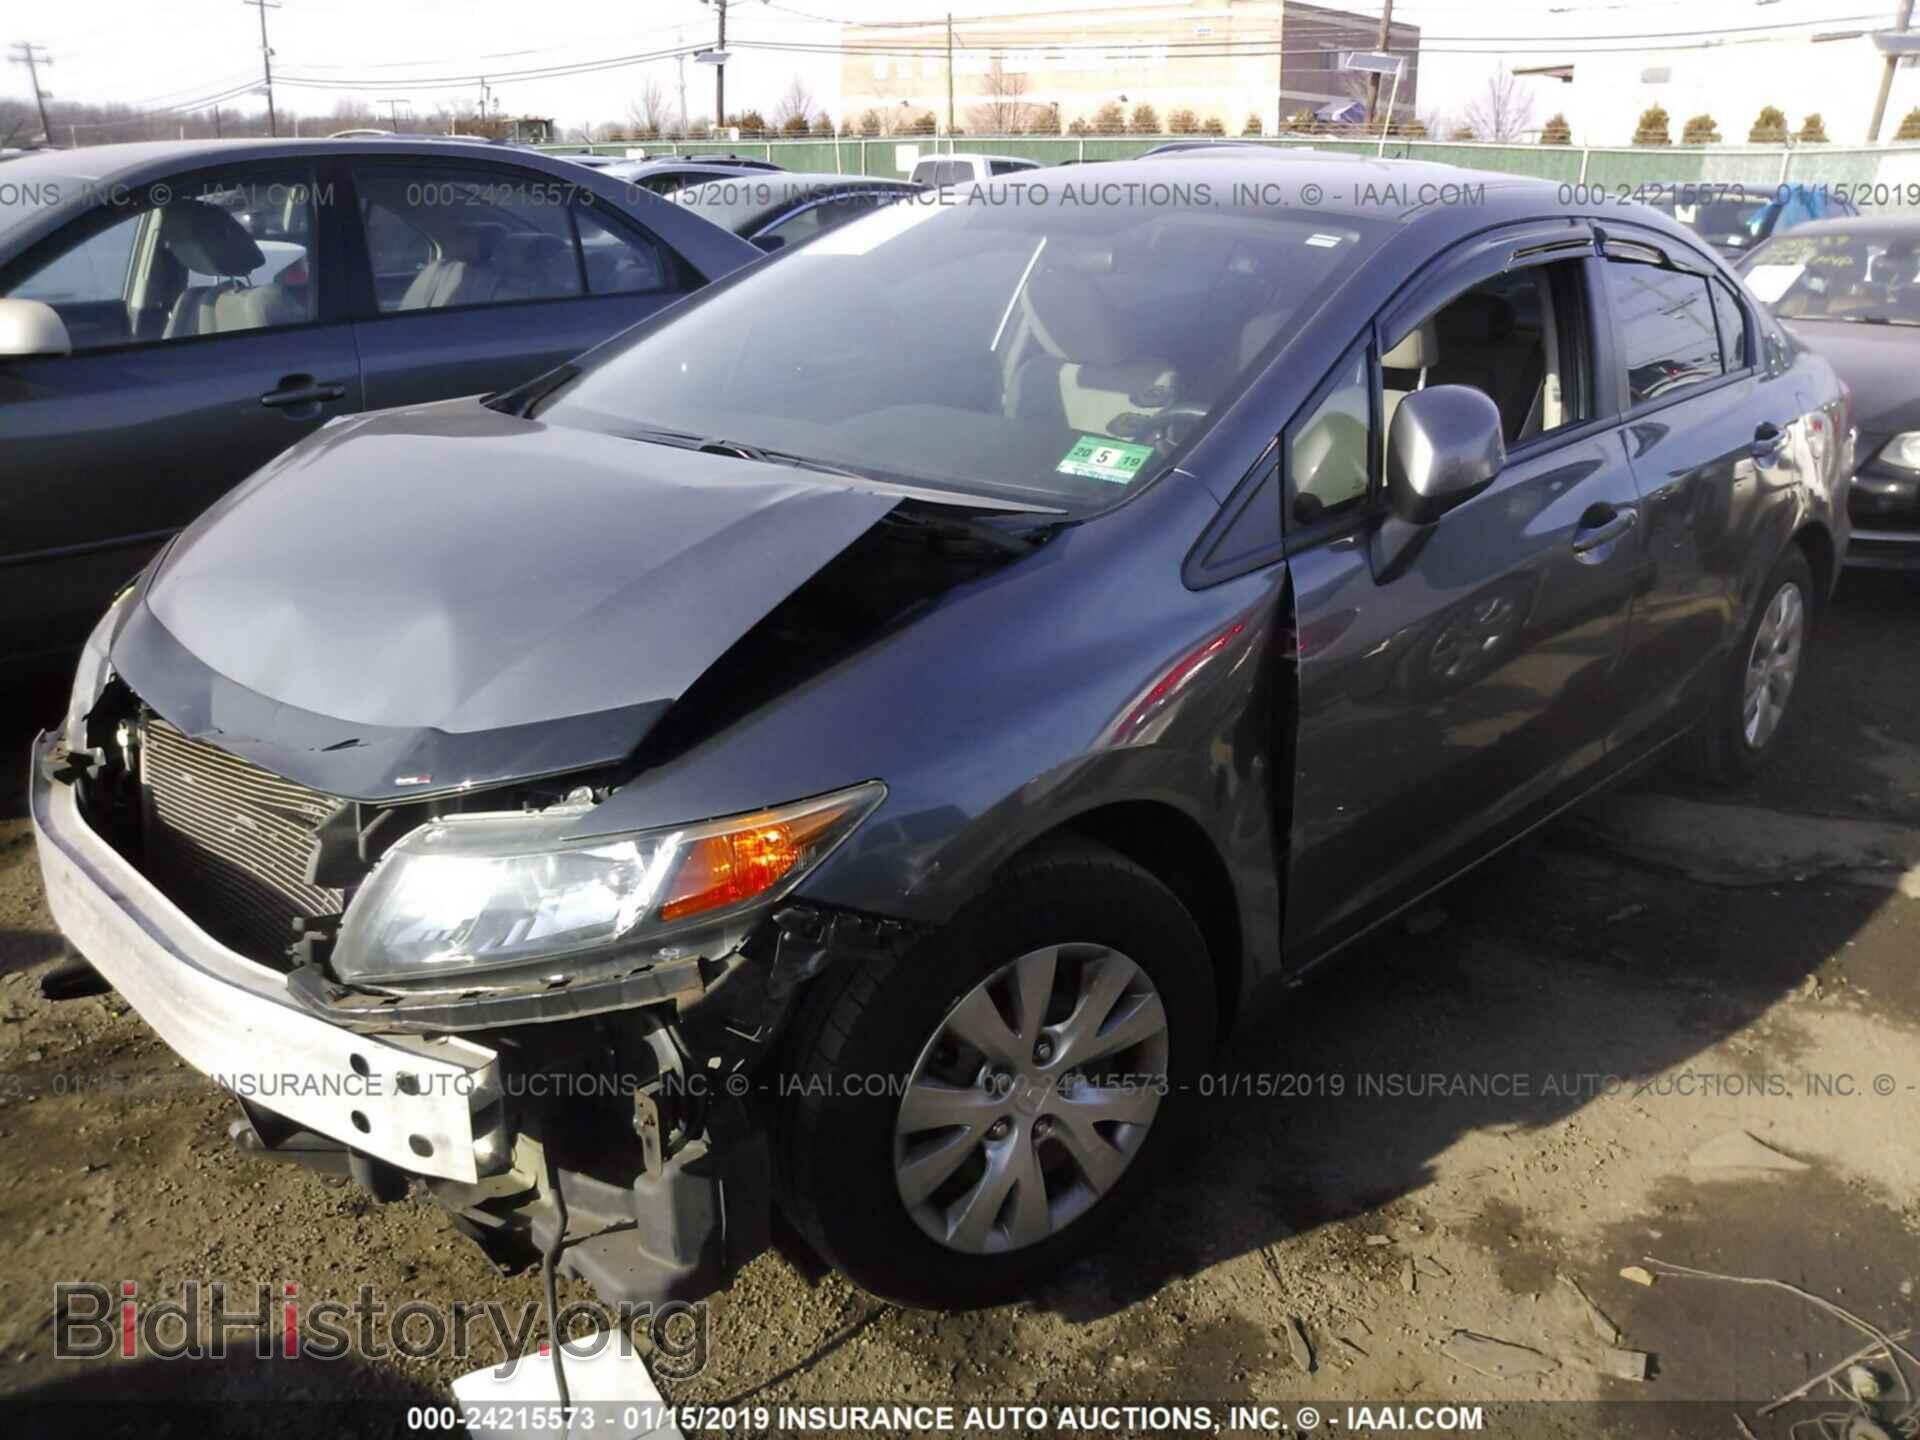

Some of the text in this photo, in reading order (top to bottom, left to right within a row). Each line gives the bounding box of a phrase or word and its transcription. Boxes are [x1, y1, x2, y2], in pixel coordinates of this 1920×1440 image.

[1074, 446, 1141, 467] 20 5 19
